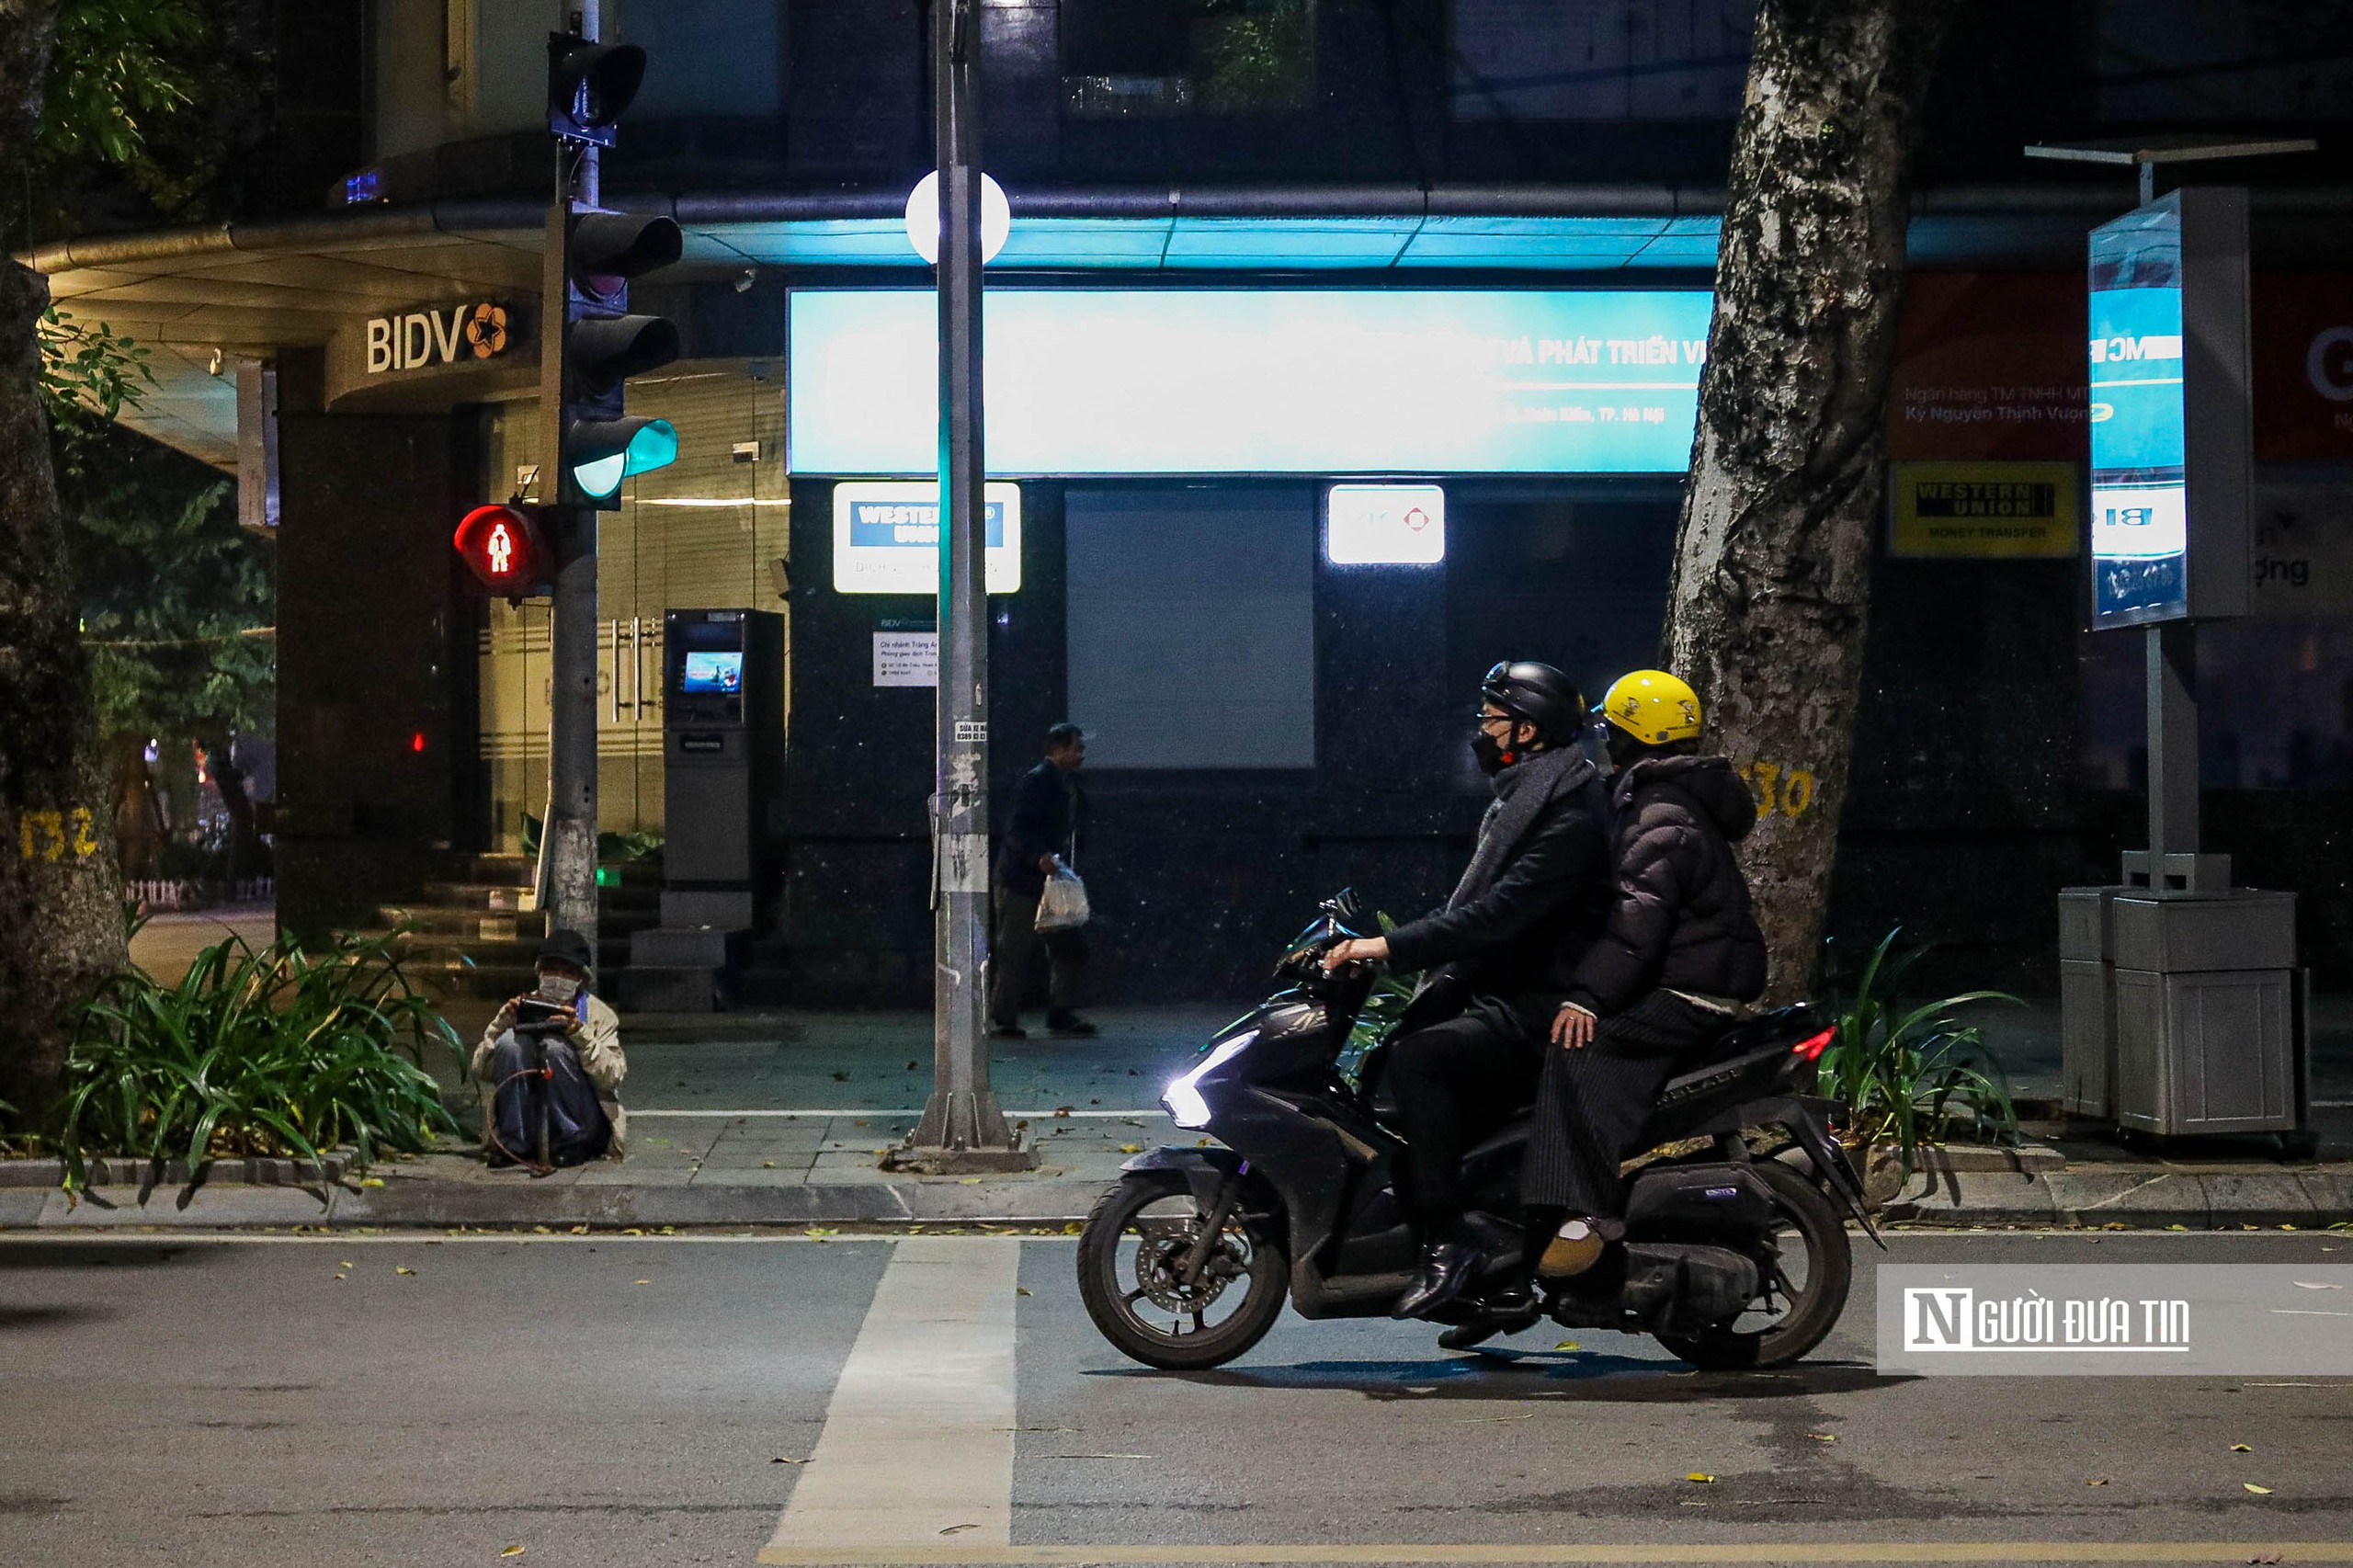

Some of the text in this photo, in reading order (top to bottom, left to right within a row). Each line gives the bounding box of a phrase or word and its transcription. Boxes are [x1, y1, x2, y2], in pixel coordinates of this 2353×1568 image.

[368, 305, 468, 374] BIDV
[1539, 335, 1603, 364] PHÁT
[1607, 334, 1677, 364] TRIỂN
[1683, 340, 1707, 364] VI
[2306, 326, 2353, 402] G
[2046, 405, 2090, 423] Vượn
[1917, 483, 2031, 499] WESTERN
[858, 506, 939, 525] WESTE
[1953, 499, 2031, 517] UNION
[1930, 527, 2048, 539] MONEY TRANSFER
[1740, 761, 1813, 818] 30
